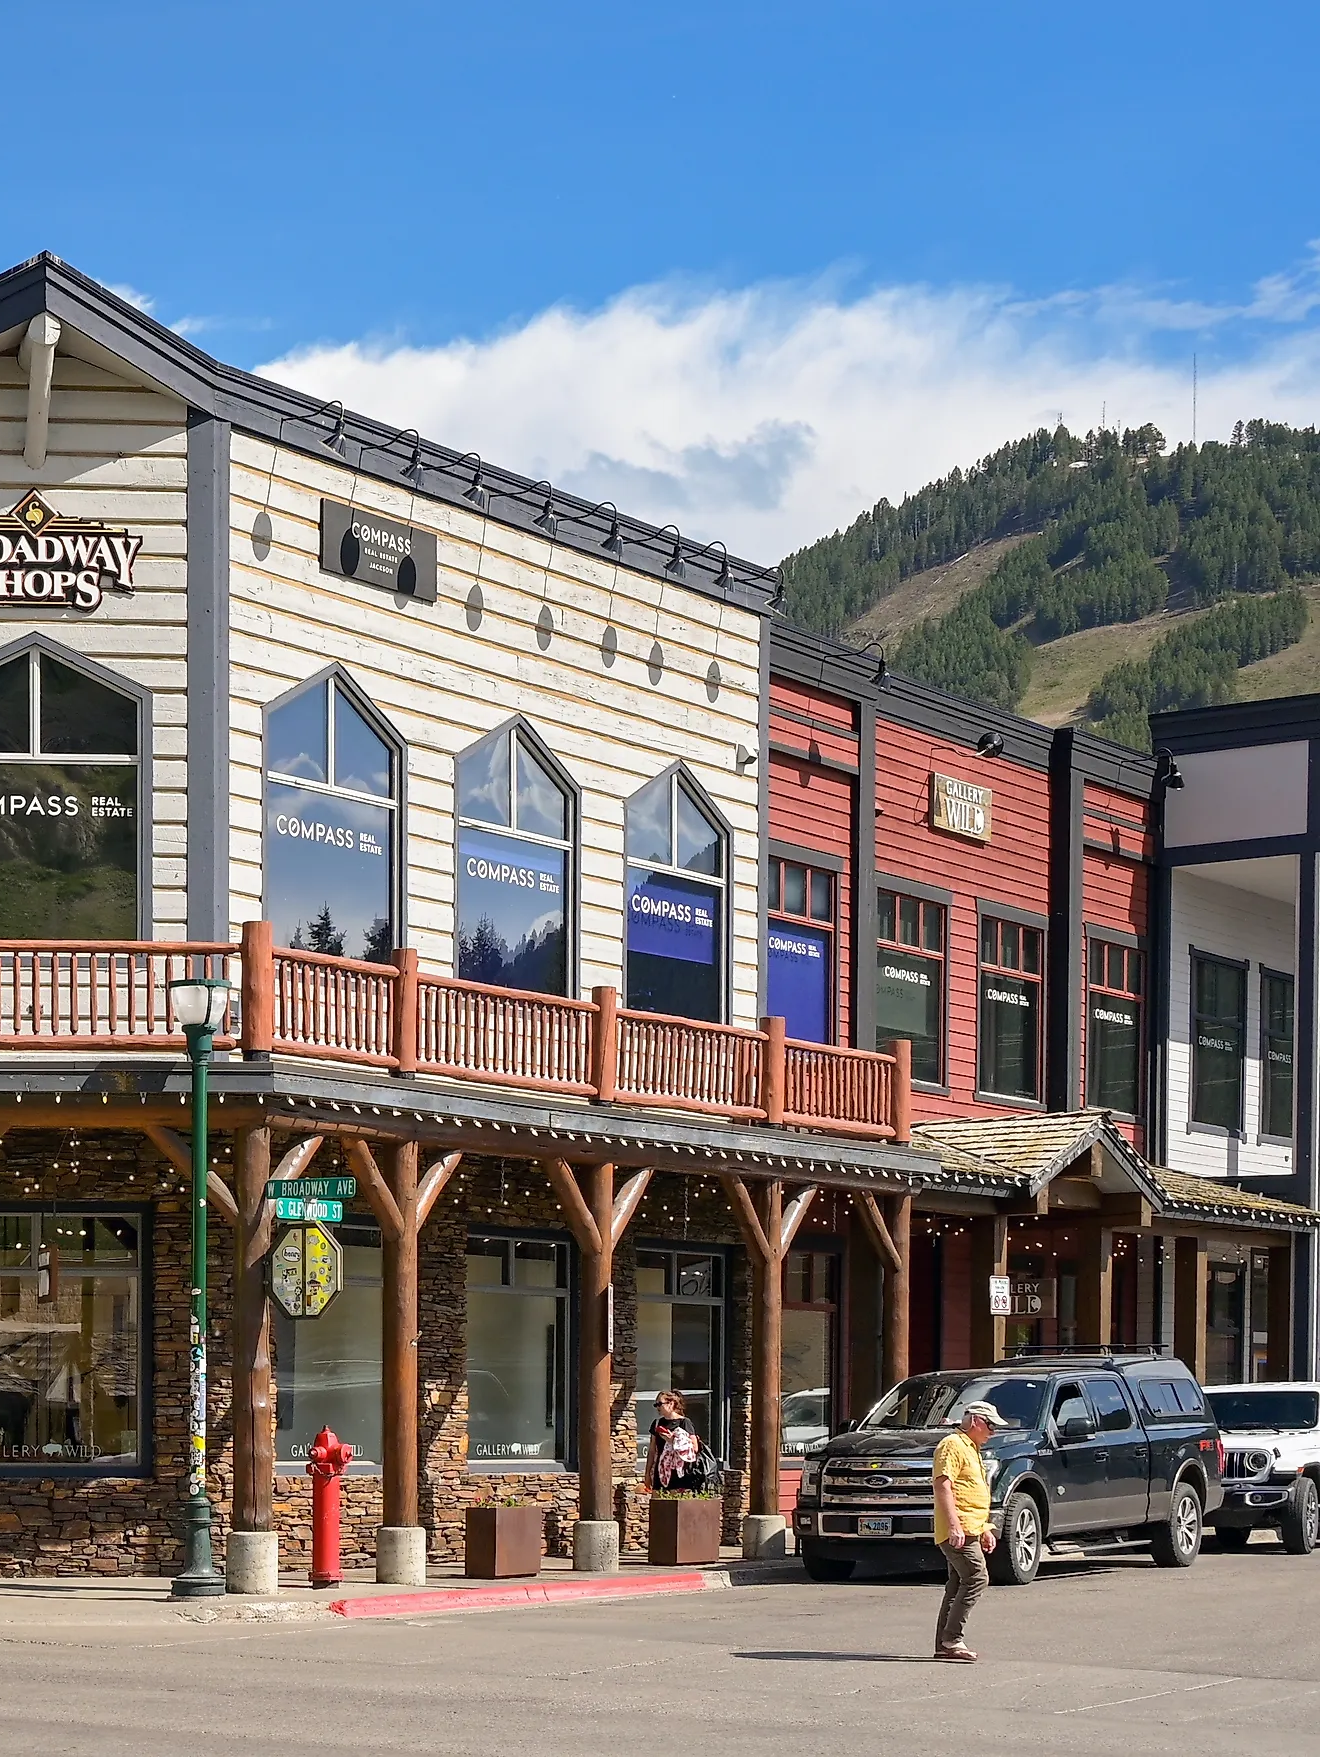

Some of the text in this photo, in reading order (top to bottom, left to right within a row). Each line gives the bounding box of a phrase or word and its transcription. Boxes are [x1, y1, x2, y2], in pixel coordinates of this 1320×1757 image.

[351, 521, 411, 555] COMPASS
[946, 780, 984, 804] GALLERY
[91, 796, 122, 806] REAL
[91, 807, 134, 818] ESTATE
[945, 797, 985, 834] WILD
[276, 814, 354, 849] COMPASS
[359, 832, 376, 844] REAL
[359, 842, 383, 856] ESTATE
[466, 857, 535, 888] COMPASS
[539, 872, 555, 884] REAL
[539, 881, 560, 894] ESTATE
[631, 894, 692, 923] COMPASS
[768, 936, 807, 955] COMPASS
[885, 965, 919, 984] COMPASS
[987, 988, 1019, 1005] COMPASS
[1095, 1008, 1124, 1024] COMPASS
[1198, 1035, 1224, 1050] COMPASS
[1267, 1050, 1292, 1064] COMPASS
[268, 1180, 354, 1197] W BROADWAY AVE
[278, 1200, 284, 1216] S
[332, 1204, 341, 1219] ST
[1011, 1283, 1040, 1294] LERY
[64, 1444, 101, 1458] WILD
[351, 1444, 364, 1457] ILD
[476, 1443, 540, 1456] GALLERY WILD
[781, 1443, 796, 1454] LERY
